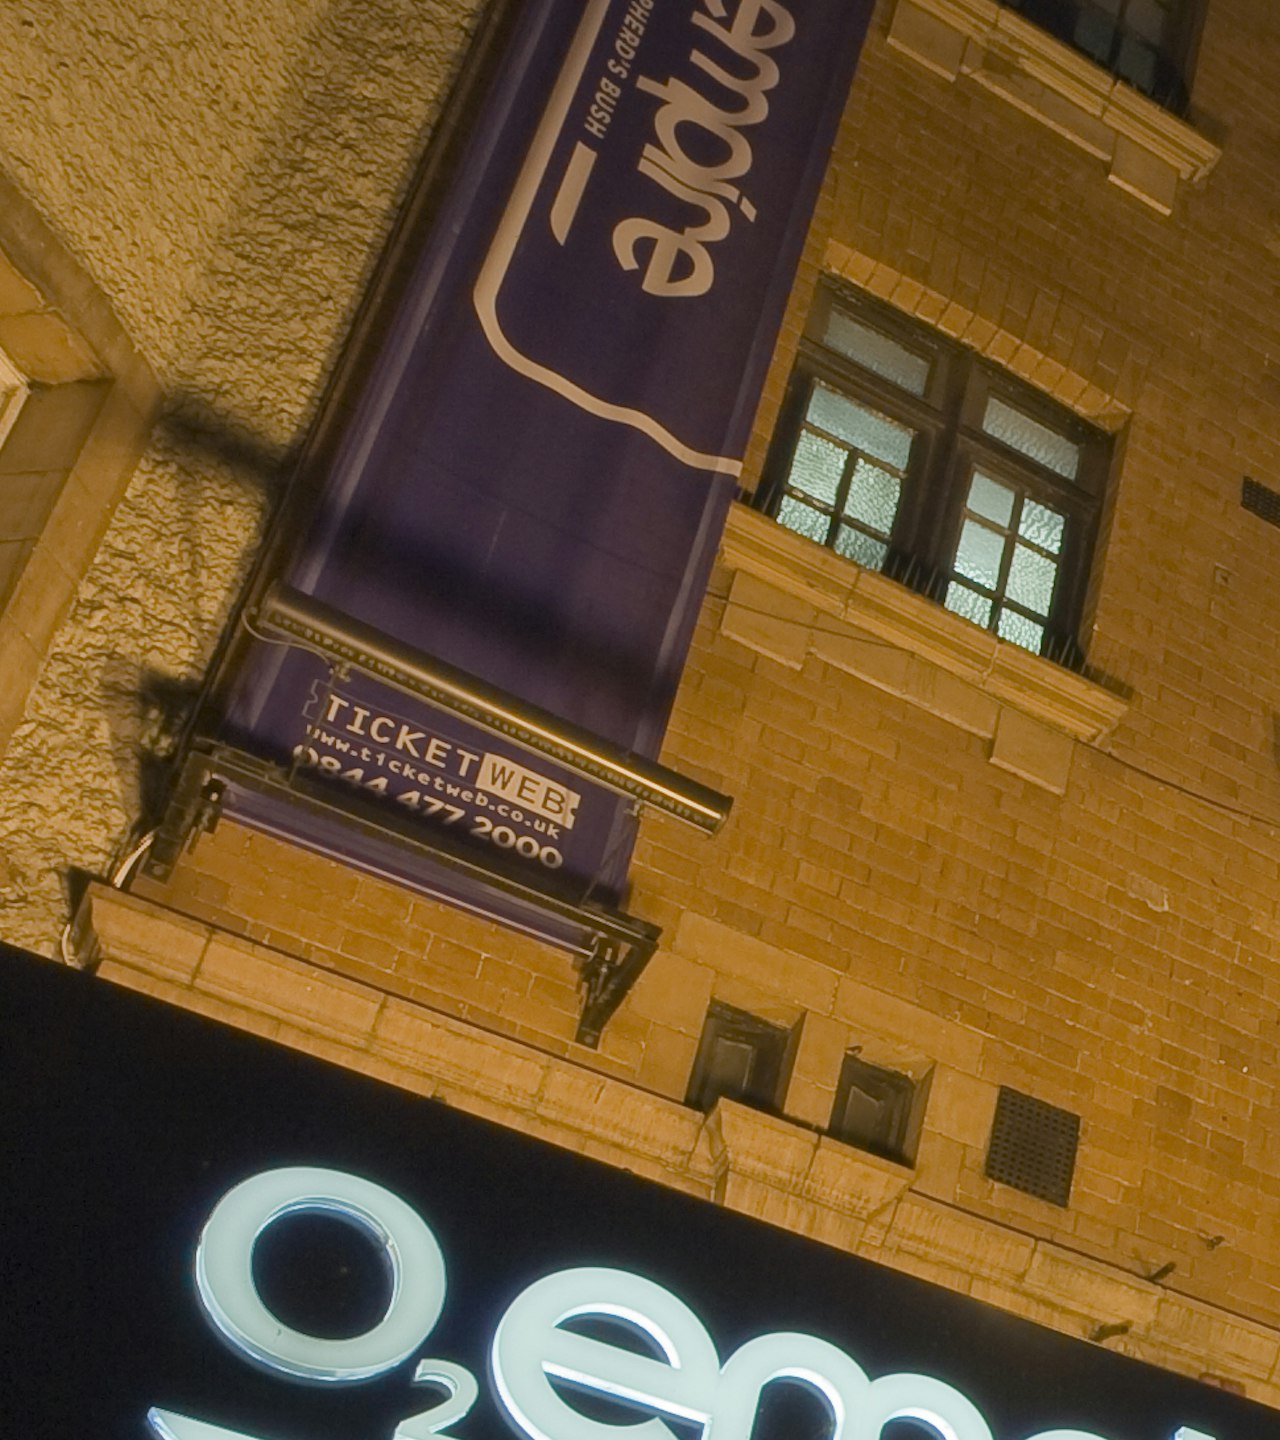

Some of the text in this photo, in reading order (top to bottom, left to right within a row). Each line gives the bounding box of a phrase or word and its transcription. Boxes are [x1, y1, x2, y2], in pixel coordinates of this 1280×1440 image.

[584, 74, 622, 139] BUSH
[305, 723, 562, 841] www.ticketweb.co.uk
[397, 790, 466, 825] 477
[471, 815, 563, 869] 2000
